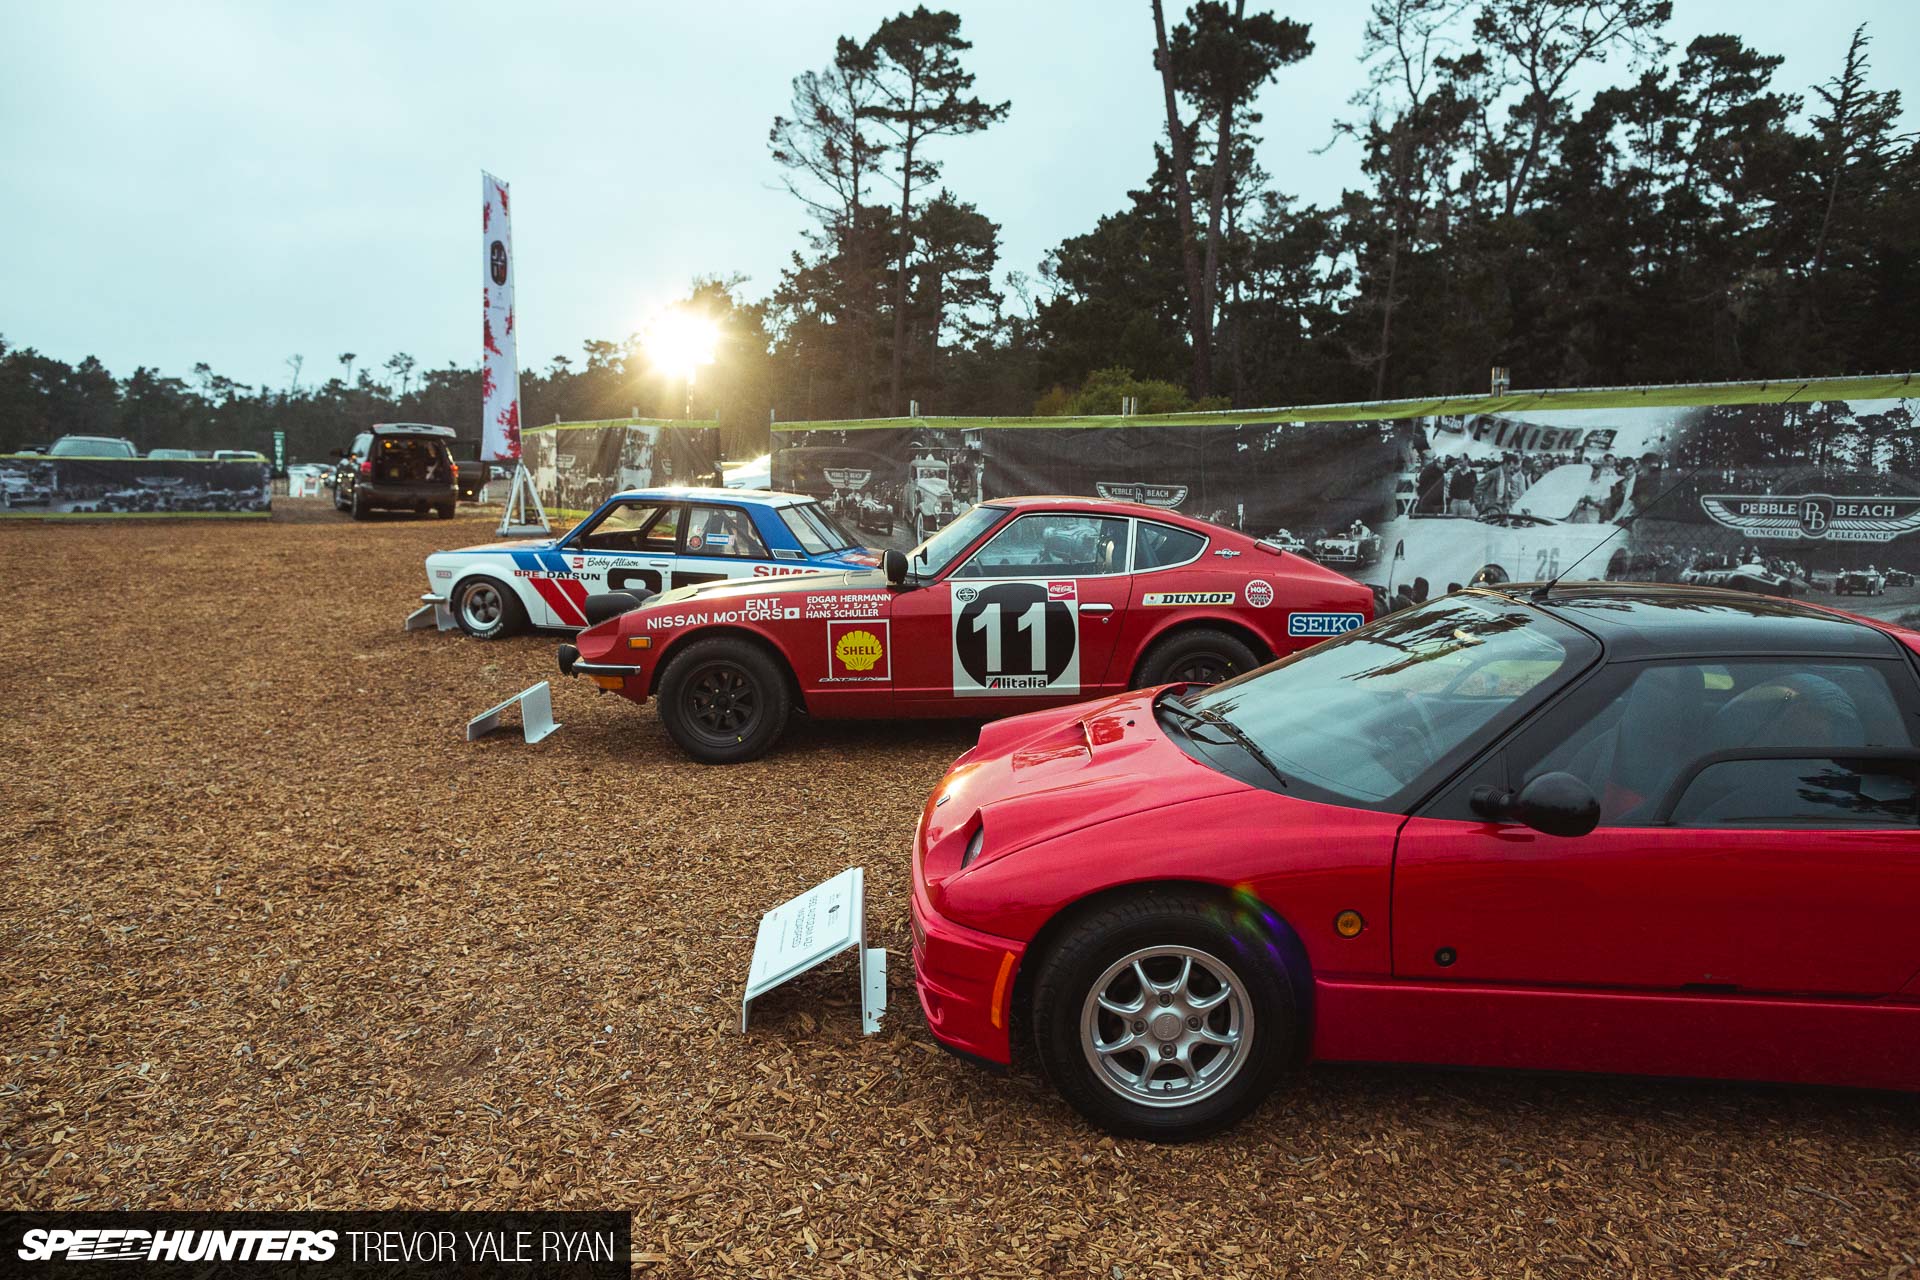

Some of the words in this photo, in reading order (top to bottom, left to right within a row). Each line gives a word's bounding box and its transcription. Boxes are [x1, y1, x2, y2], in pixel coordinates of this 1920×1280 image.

[1473, 415, 1578, 450] FINISH
[1111, 487, 1133, 496] PEBBLE
[1146, 489, 1169, 498] BEACH
[1740, 503, 1797, 515] PEBBLE
[1836, 504, 1896, 517] BEACH
[1745, 529, 1800, 538] CONCOURS
[587, 557, 611, 570] Bobby
[610, 557, 639, 567] Allison
[1535, 547, 1560, 581] 26
[514, 570, 540, 578] BRE
[546, 571, 600, 580] DATSUN
[745, 598, 783, 611] ENT.
[806, 595, 837, 604] EDGAR
[840, 593, 892, 603] HERRMANN
[1162, 593, 1233, 604] DUNLOP
[647, 612, 708, 630] NISSAN
[713, 608, 783, 623] MOTORS
[805, 610, 832, 619] HANS
[834, 608, 879, 618] SCHULLER
[1292, 616, 1360, 633] SEIKO
[972, 602, 1047, 672] 11
[843, 646, 877, 656] SHELL
[988, 677, 1047, 689] Alitalia
